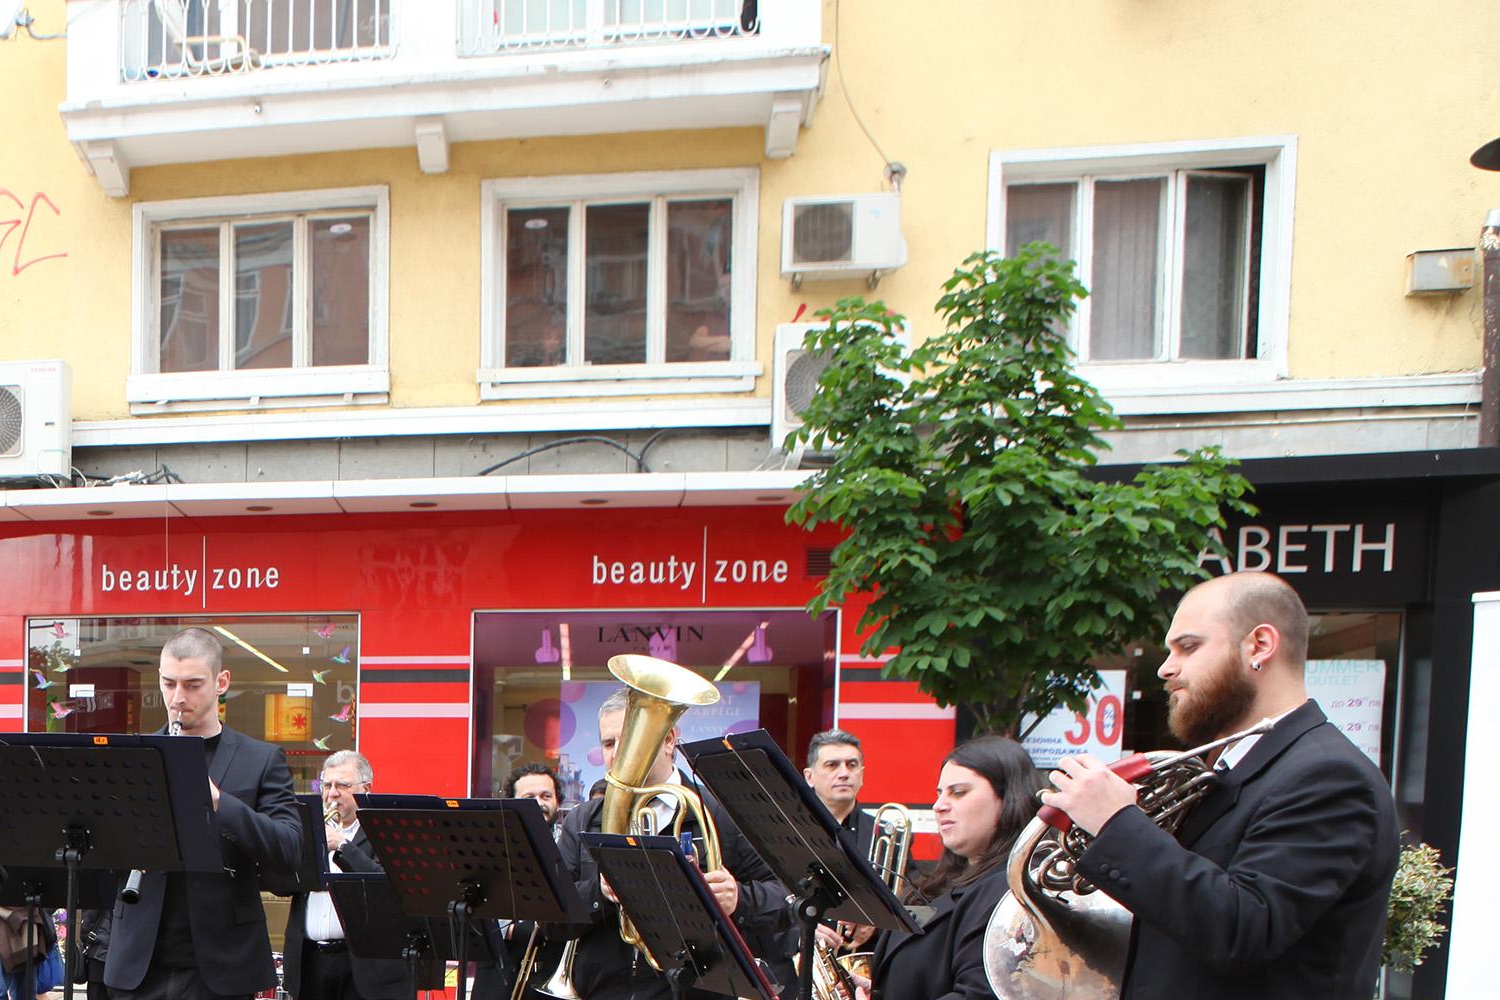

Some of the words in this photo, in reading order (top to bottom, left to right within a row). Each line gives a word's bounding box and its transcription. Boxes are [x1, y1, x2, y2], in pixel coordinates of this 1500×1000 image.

[101, 564, 197, 596] beauty
[212, 566, 279, 590] zone
[592, 555, 696, 590] beauty
[713, 559, 789, 583] zone
[598, 624, 705, 642] LANVIN
